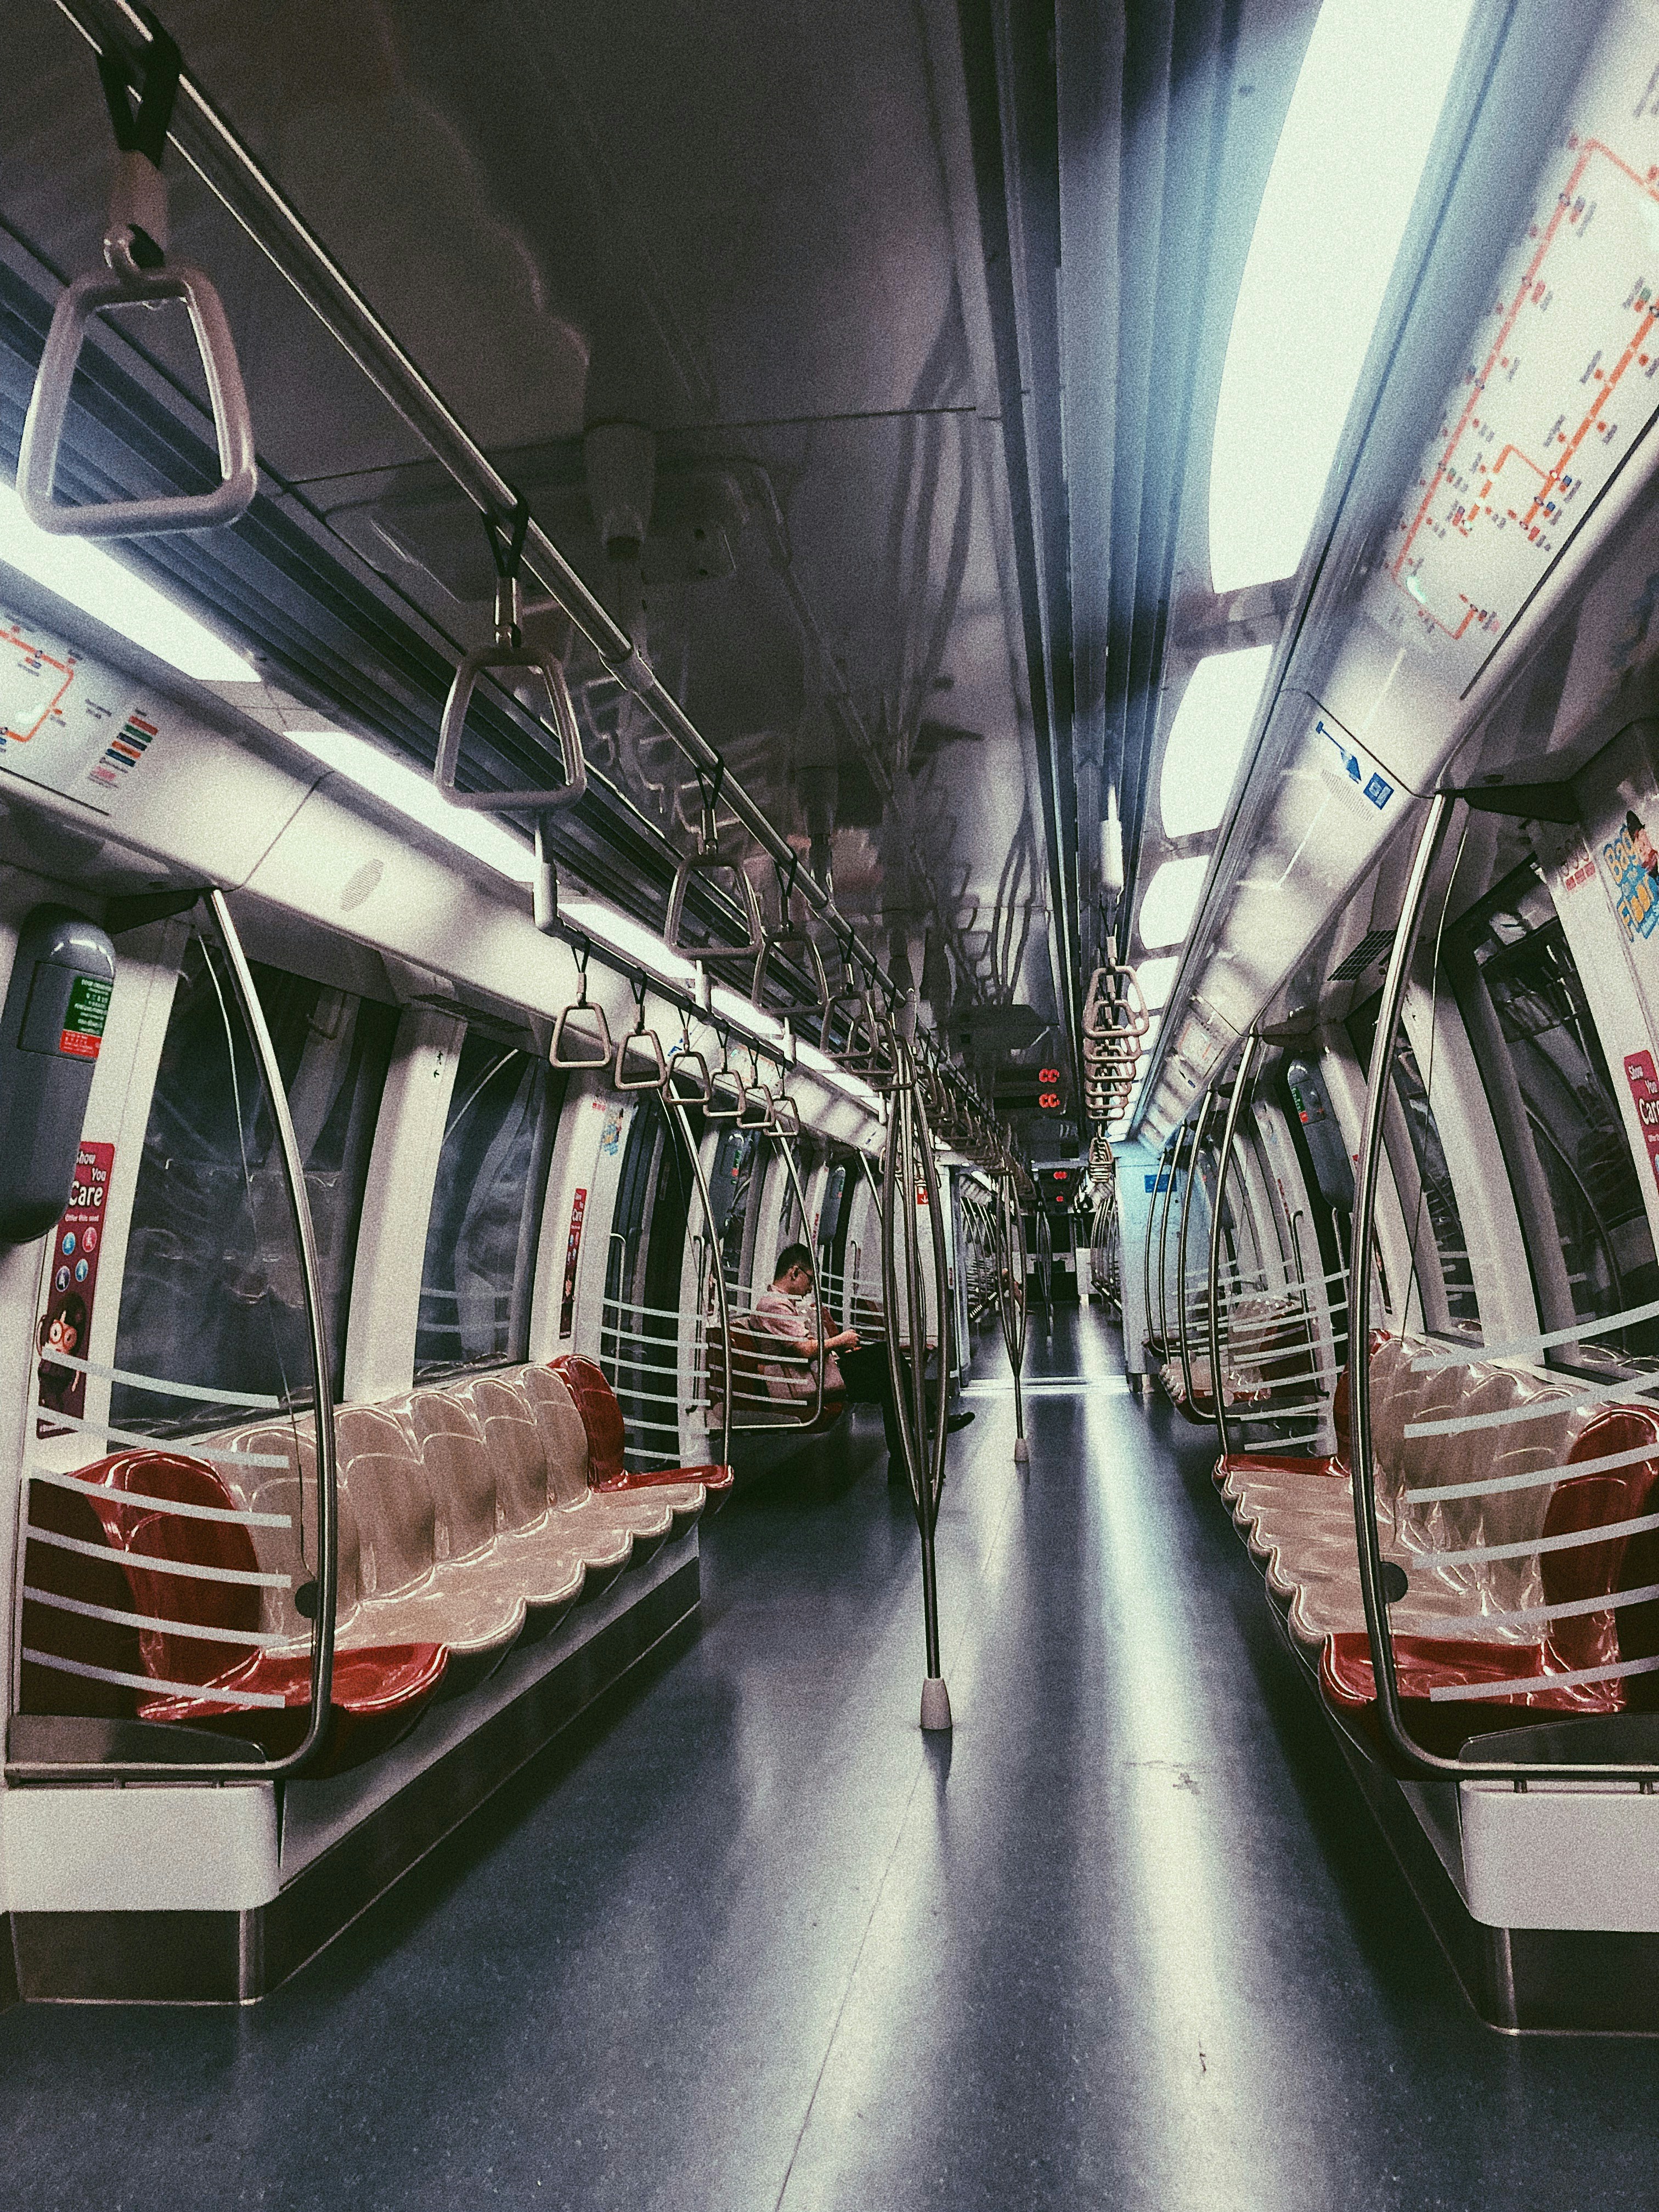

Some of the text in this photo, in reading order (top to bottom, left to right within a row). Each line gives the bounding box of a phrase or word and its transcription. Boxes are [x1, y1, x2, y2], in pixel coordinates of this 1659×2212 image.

[1604, 828, 1639, 884] Bag
[1618, 873, 1654, 941] Floor
[69, 1181, 103, 1206] Care
[92, 1167, 106, 1181] You
